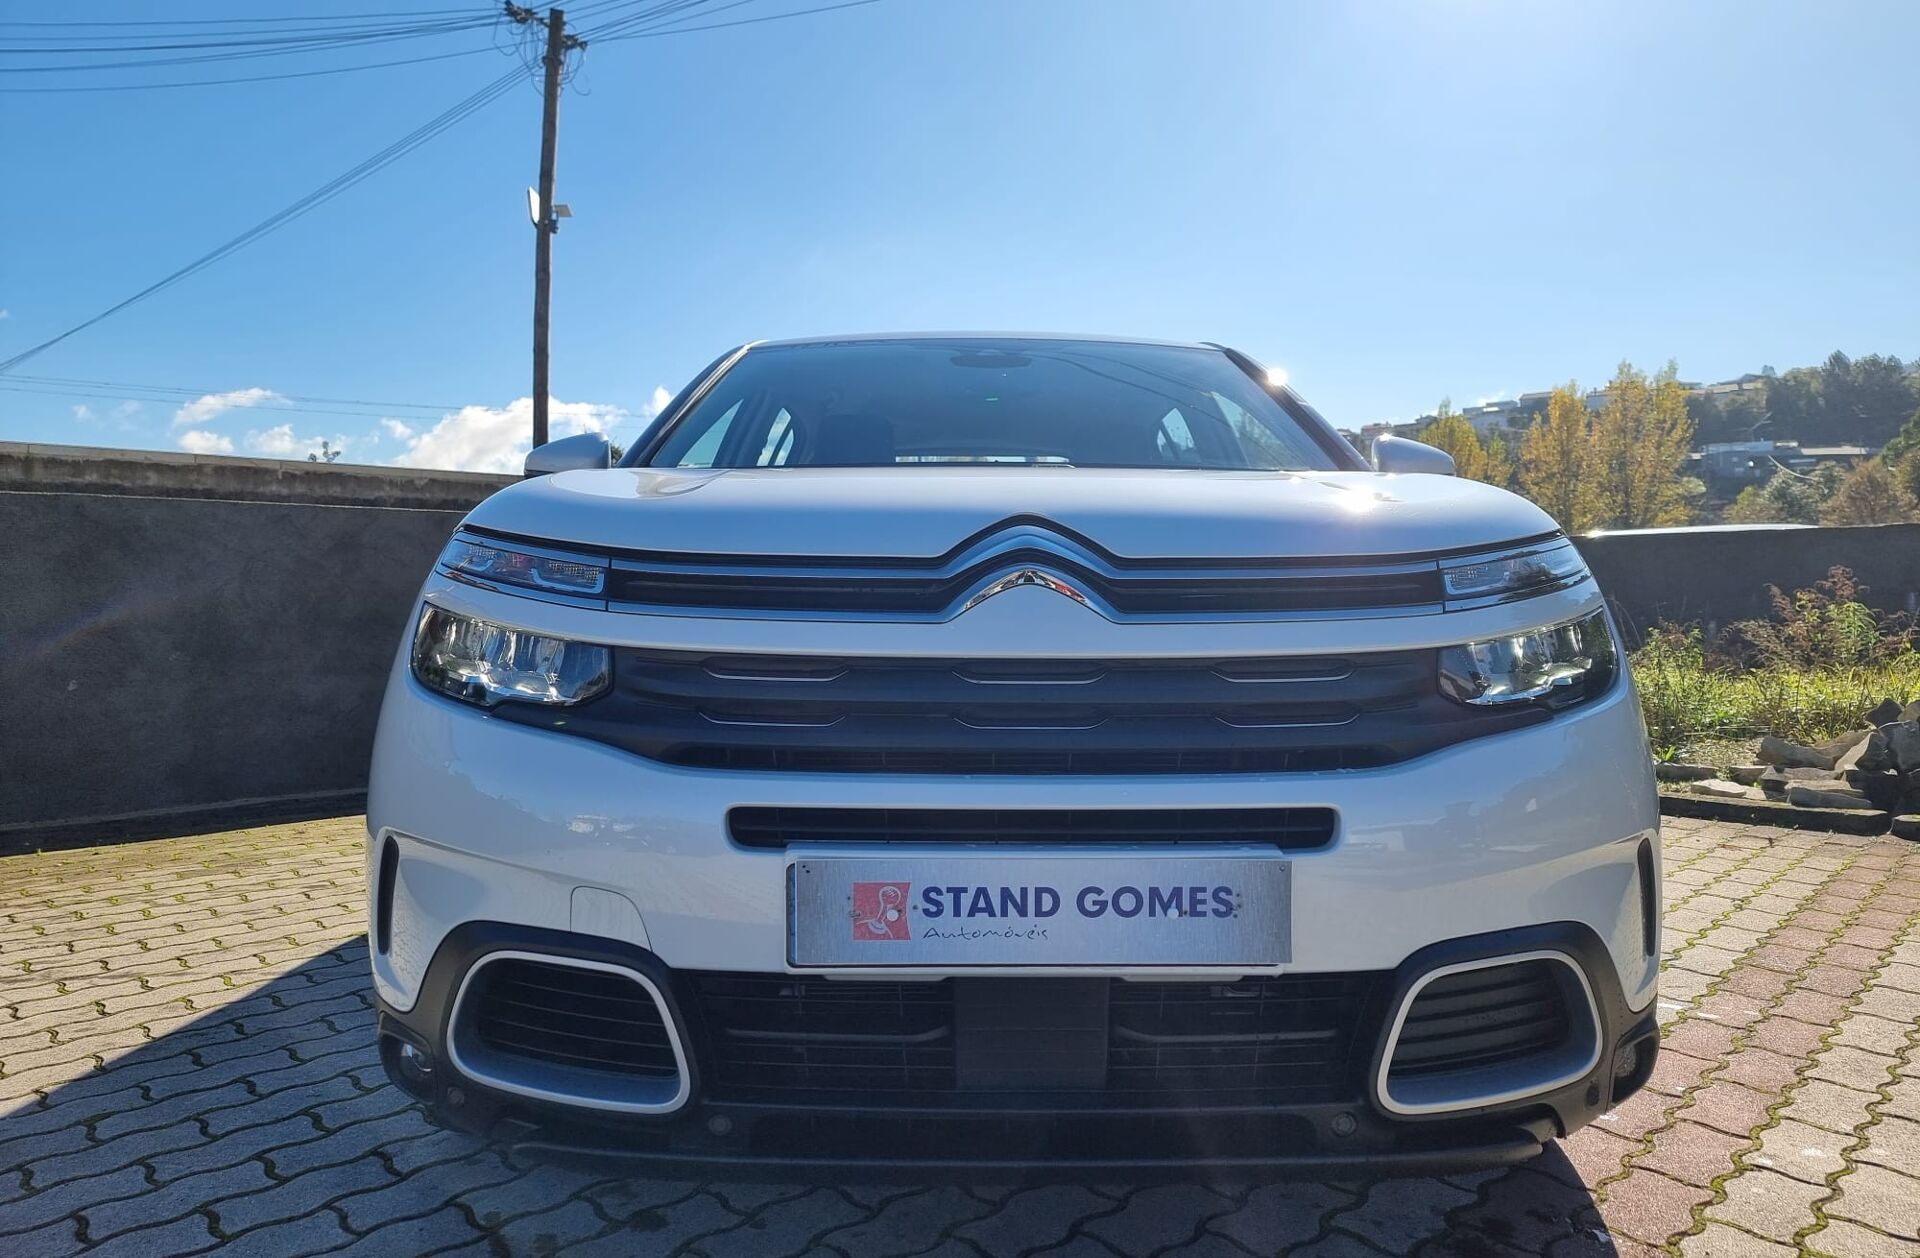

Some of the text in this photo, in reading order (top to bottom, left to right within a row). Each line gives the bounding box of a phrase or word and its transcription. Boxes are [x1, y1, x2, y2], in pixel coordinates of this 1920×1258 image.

[921, 885, 1234, 919] STAND GOMES
[922, 924, 1049, 941] Automóveis
